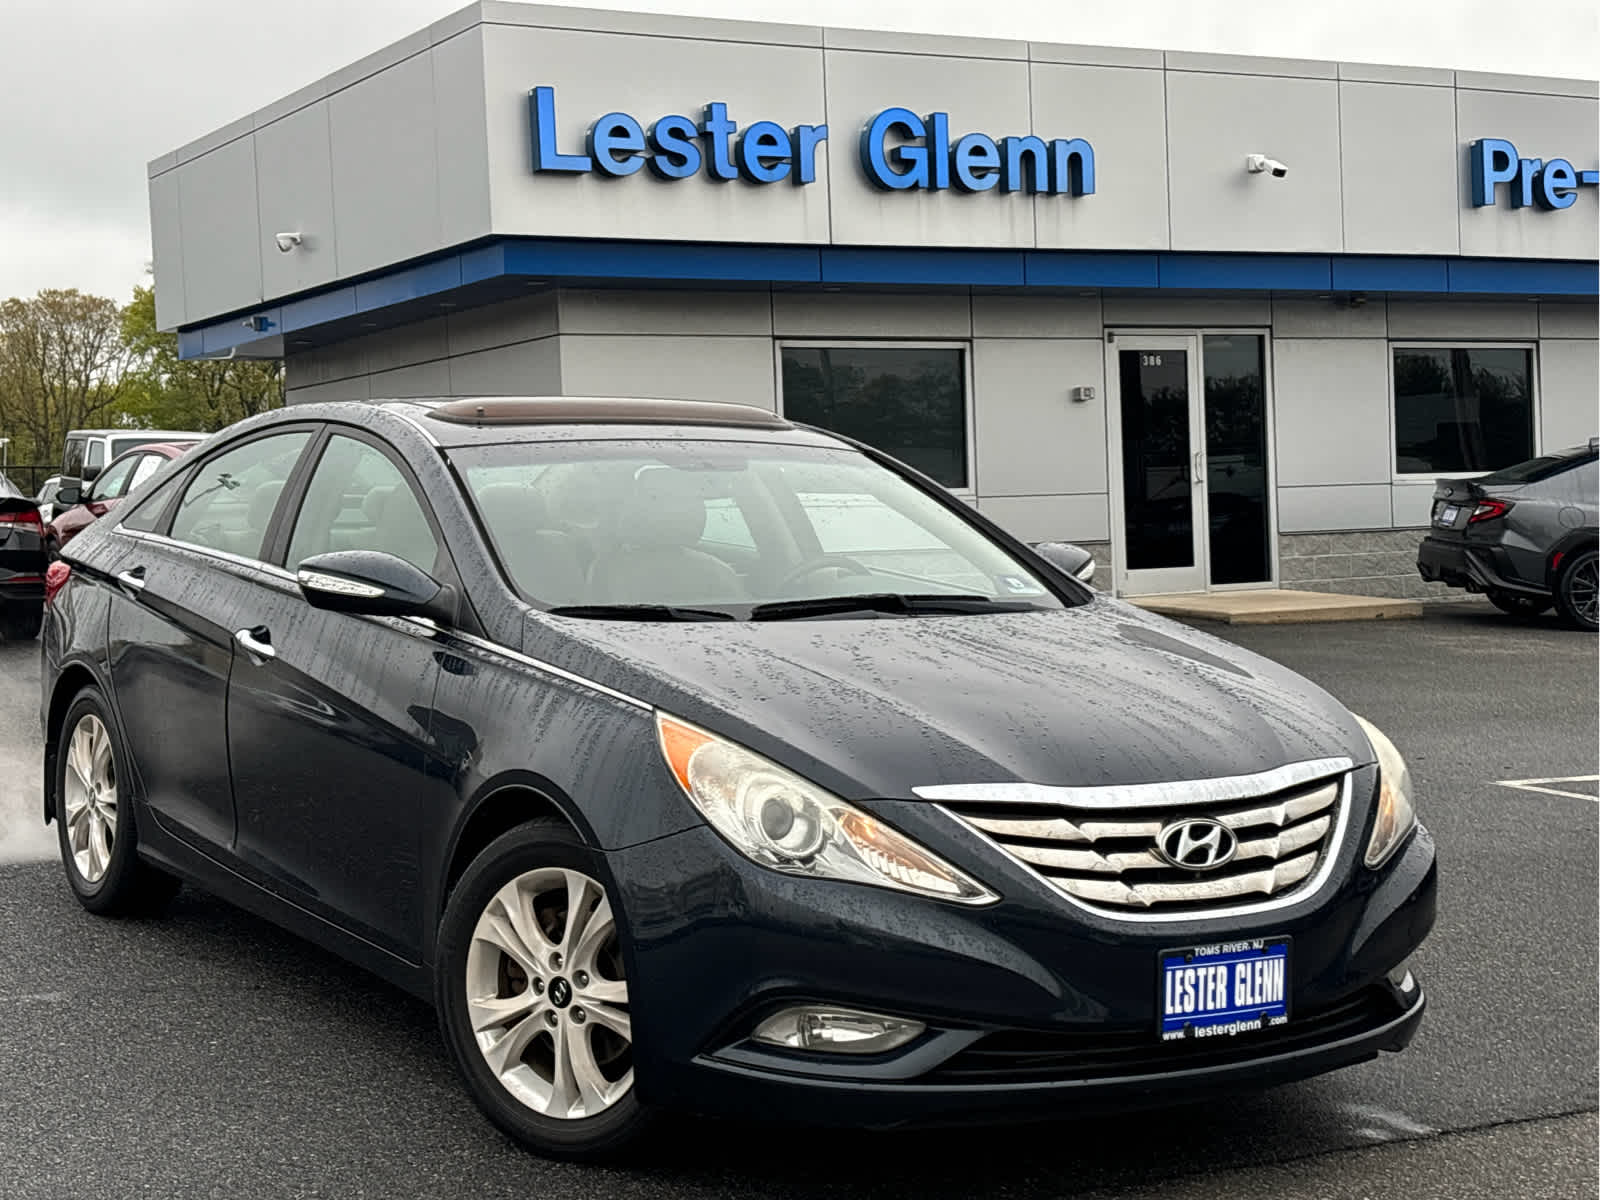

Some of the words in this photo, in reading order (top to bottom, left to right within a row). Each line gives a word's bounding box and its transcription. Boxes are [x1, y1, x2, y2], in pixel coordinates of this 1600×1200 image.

[530, 86, 828, 185] Lester
[862, 107, 1096, 196] Glenn
[1143, 355, 1162, 366] 386
[1194, 945, 1221, 957] TOMS
[1253, 939, 1264, 949] NJ
[1165, 965, 1228, 1015] LESTER
[1234, 958, 1285, 1007] GLENN
